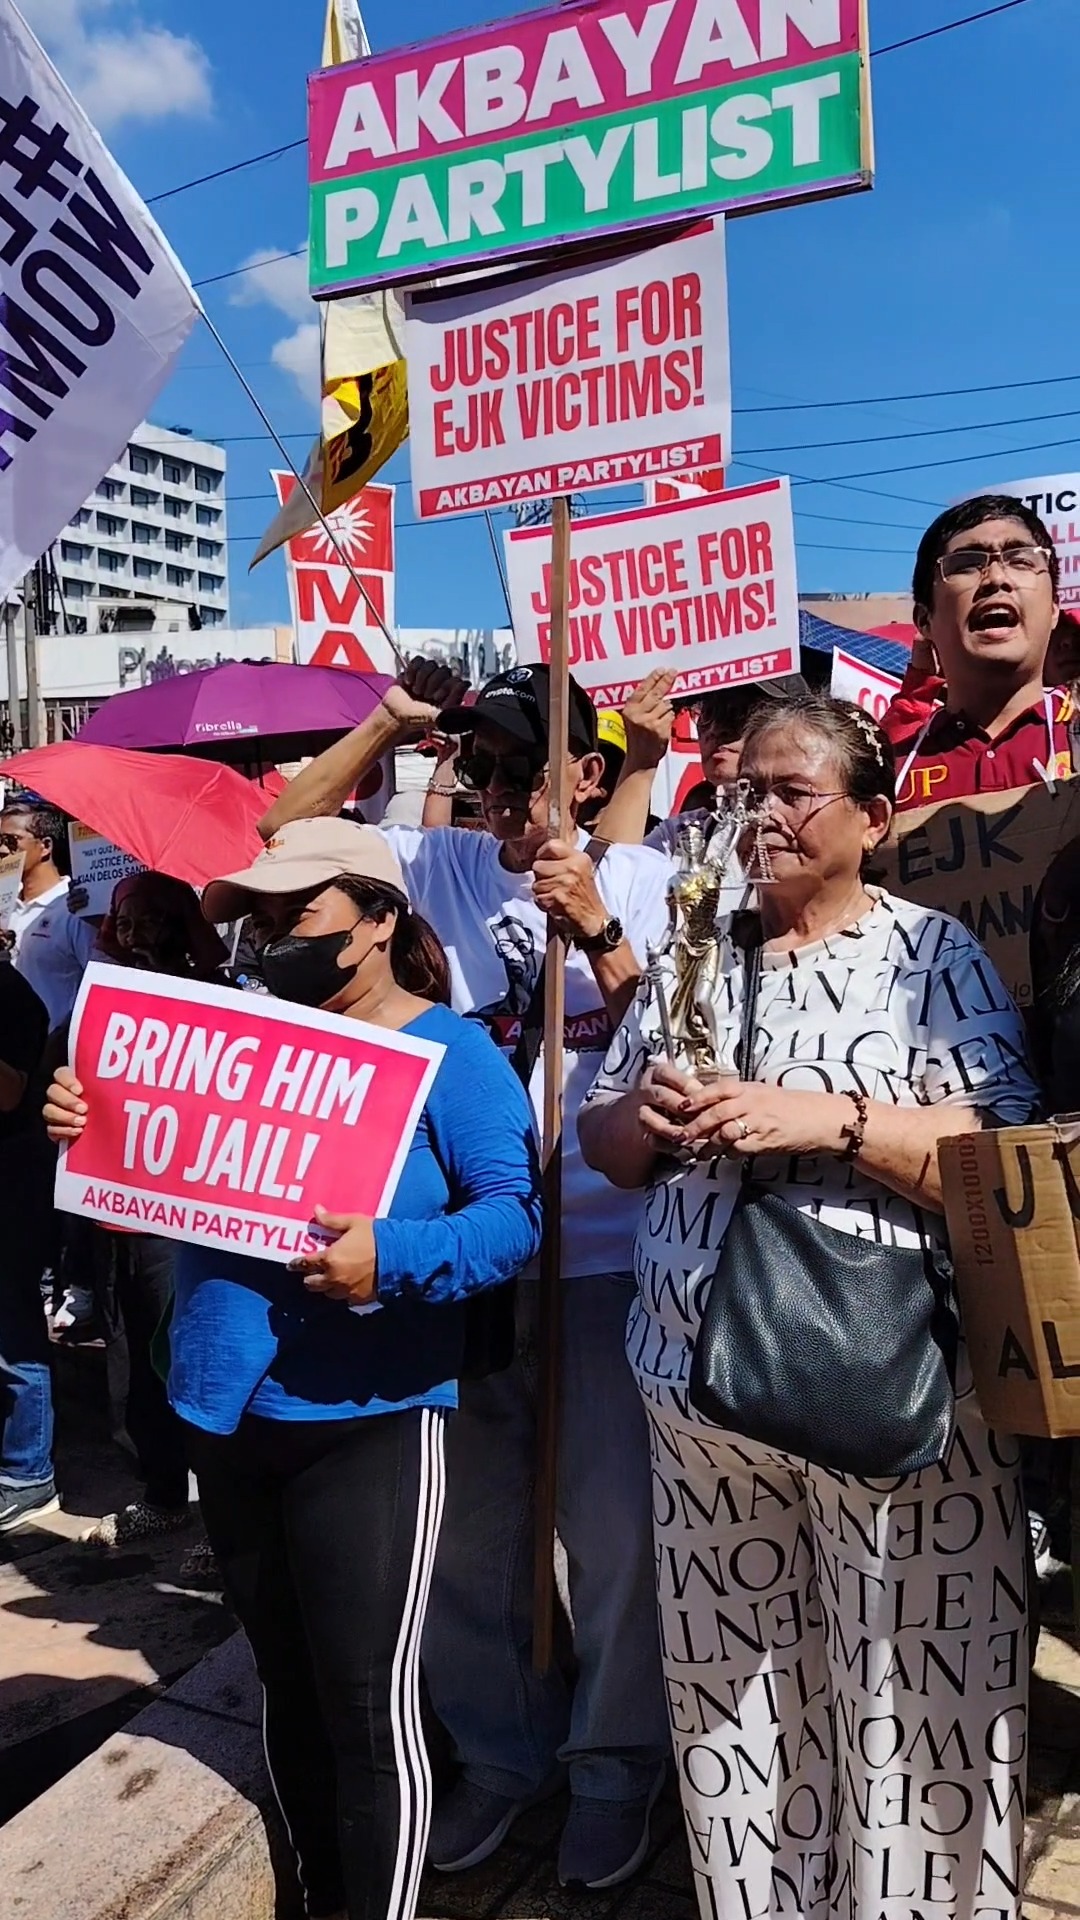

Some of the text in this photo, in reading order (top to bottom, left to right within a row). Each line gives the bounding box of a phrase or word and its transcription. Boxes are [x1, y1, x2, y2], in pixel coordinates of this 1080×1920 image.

[323, 0, 842, 170] AKBAYAN
[325, 71, 841, 269] PARTYLIST
[430, 272, 702, 393] JUSTICE FOR
[434, 345, 705, 458] EJK VICTIMS!
[435, 442, 704, 510] AKBAYAN PARTYLIST
[697, 521, 773, 586] FOR
[614, 578, 777, 656] VICTIMS!
[670, 655, 778, 693] ARTYLIST
[90, 855, 122, 870] JUSTICE
[97, 868, 123, 881] DELOS
[896, 803, 1025, 885] EJK
[96, 1011, 377, 1126] BRING HIM
[122, 1098, 321, 1202] TO JAIL!
[81, 1185, 187, 1229] AKBAYAN
